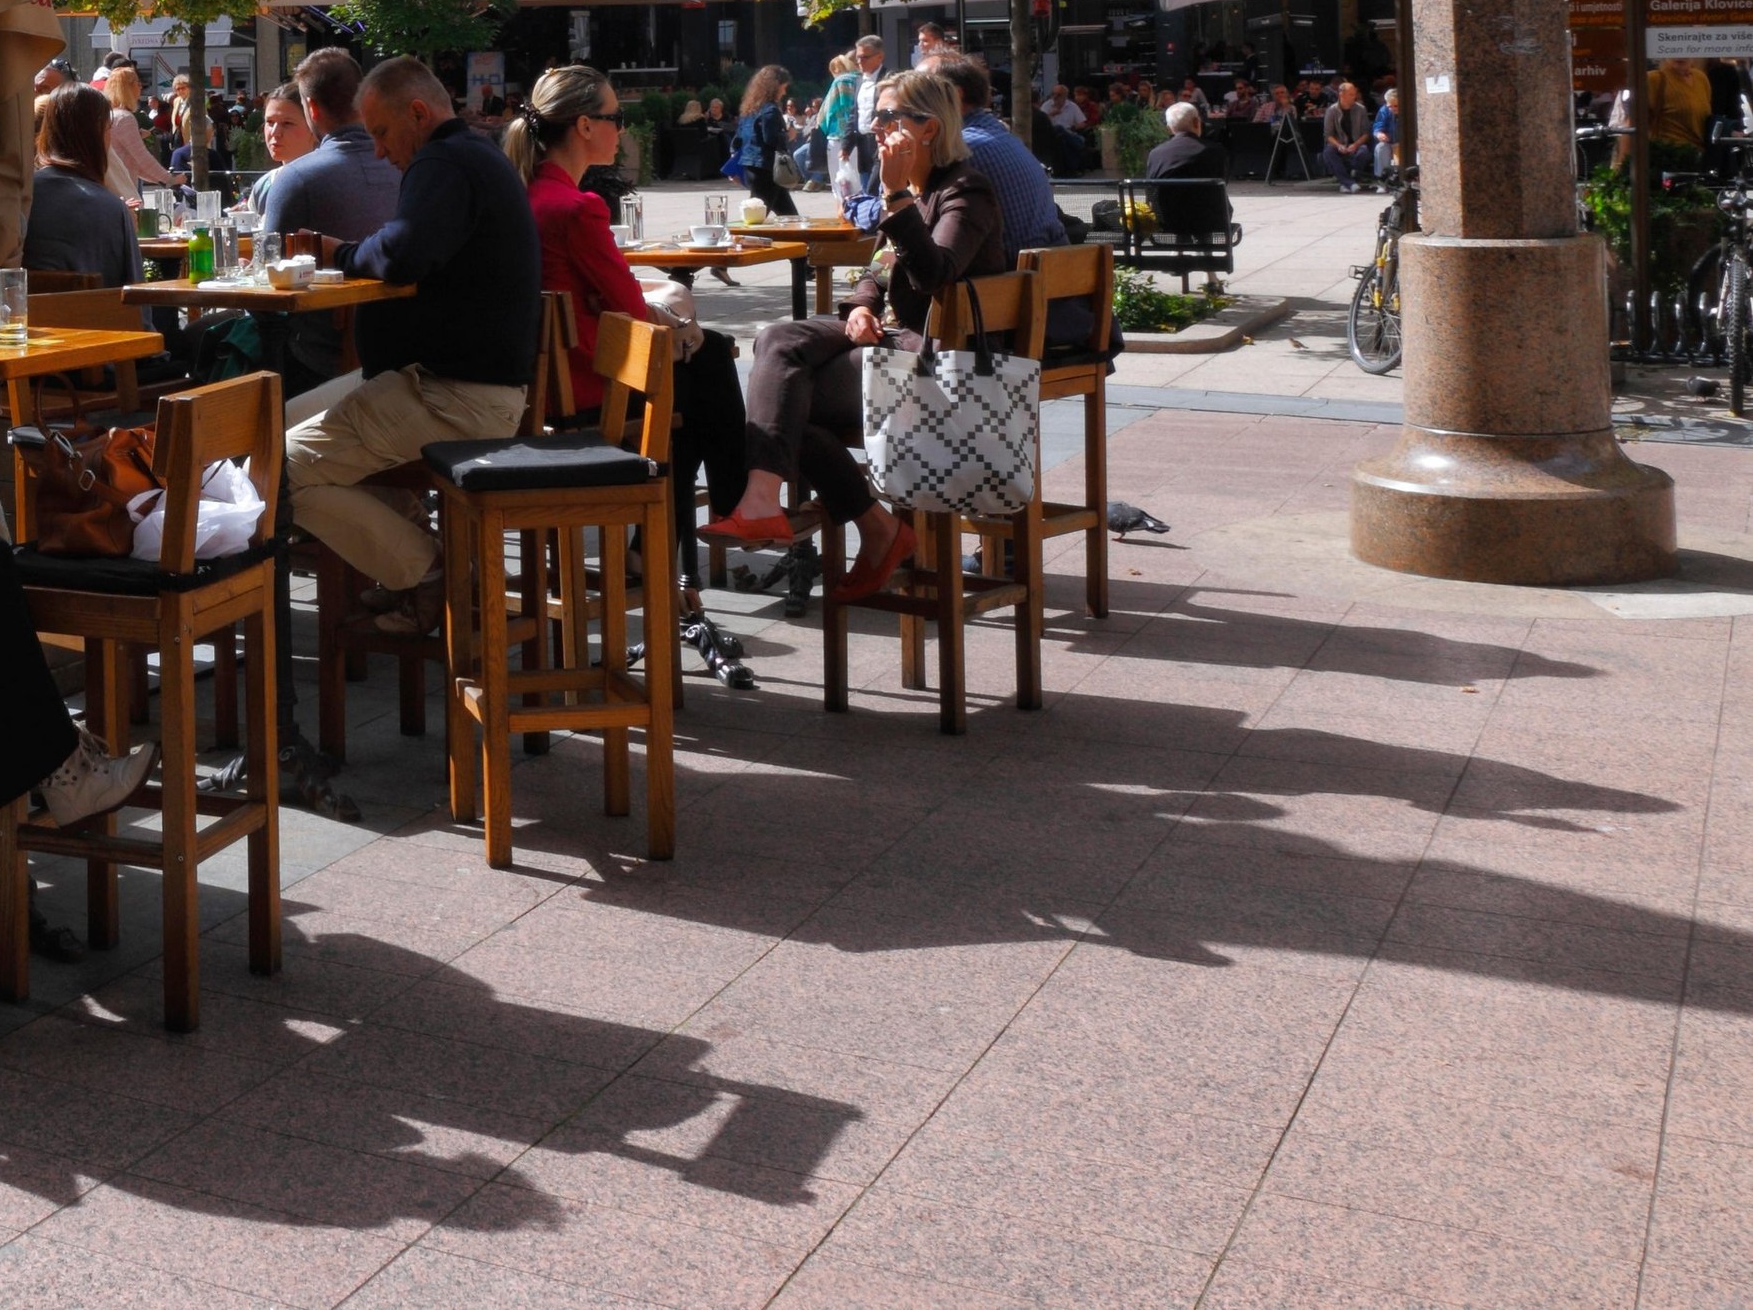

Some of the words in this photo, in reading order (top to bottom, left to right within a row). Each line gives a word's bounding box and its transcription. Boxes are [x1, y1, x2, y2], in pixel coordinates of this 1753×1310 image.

[1657, 32, 1712, 43] Skenirajte
[1731, 31, 1753, 40] više
[1657, 45, 1683, 54] Scan
[1686, 44, 1701, 53] for
[1704, 45, 1732, 53] more
[1574, 64, 1606, 76] arhiv
